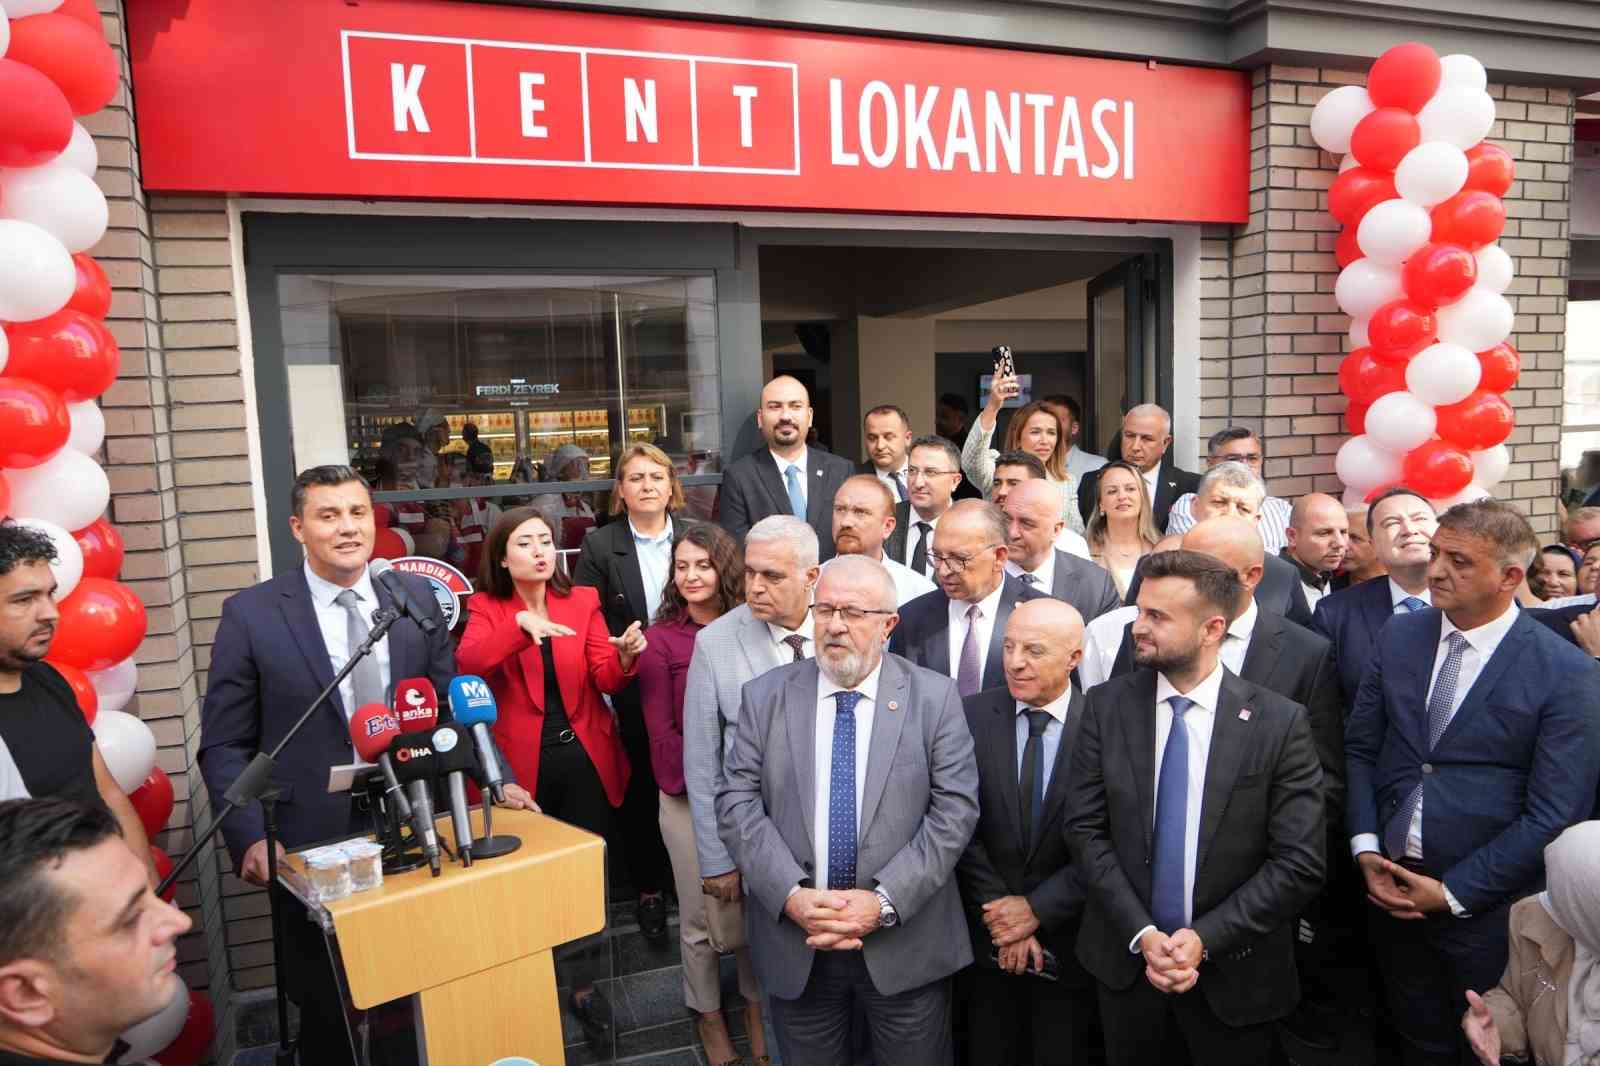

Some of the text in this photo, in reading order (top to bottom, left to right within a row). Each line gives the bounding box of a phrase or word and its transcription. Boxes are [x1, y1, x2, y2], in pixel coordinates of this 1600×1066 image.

[390, 62, 1135, 181] KENT LOKANTASI
[513, 383, 560, 394] ZEYREK
